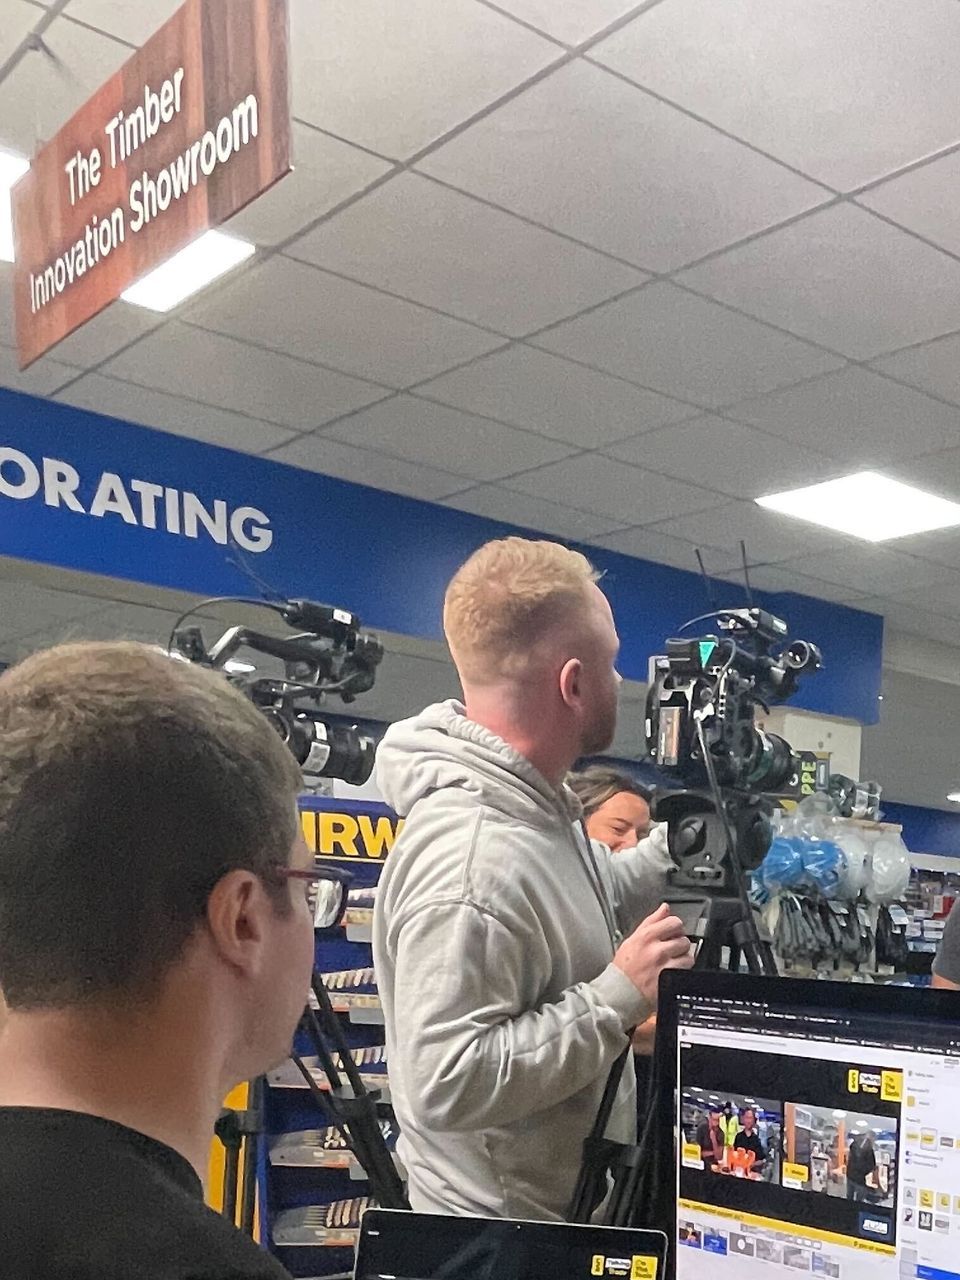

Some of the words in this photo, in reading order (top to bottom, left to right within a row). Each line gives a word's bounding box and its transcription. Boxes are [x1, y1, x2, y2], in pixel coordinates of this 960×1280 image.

[30, 206, 125, 314] Innovation
[129, 94, 258, 233] Showroom
[65, 150, 101, 205] The
[105, 67, 184, 168] Timber
[0, 447, 273, 553] ORATING
